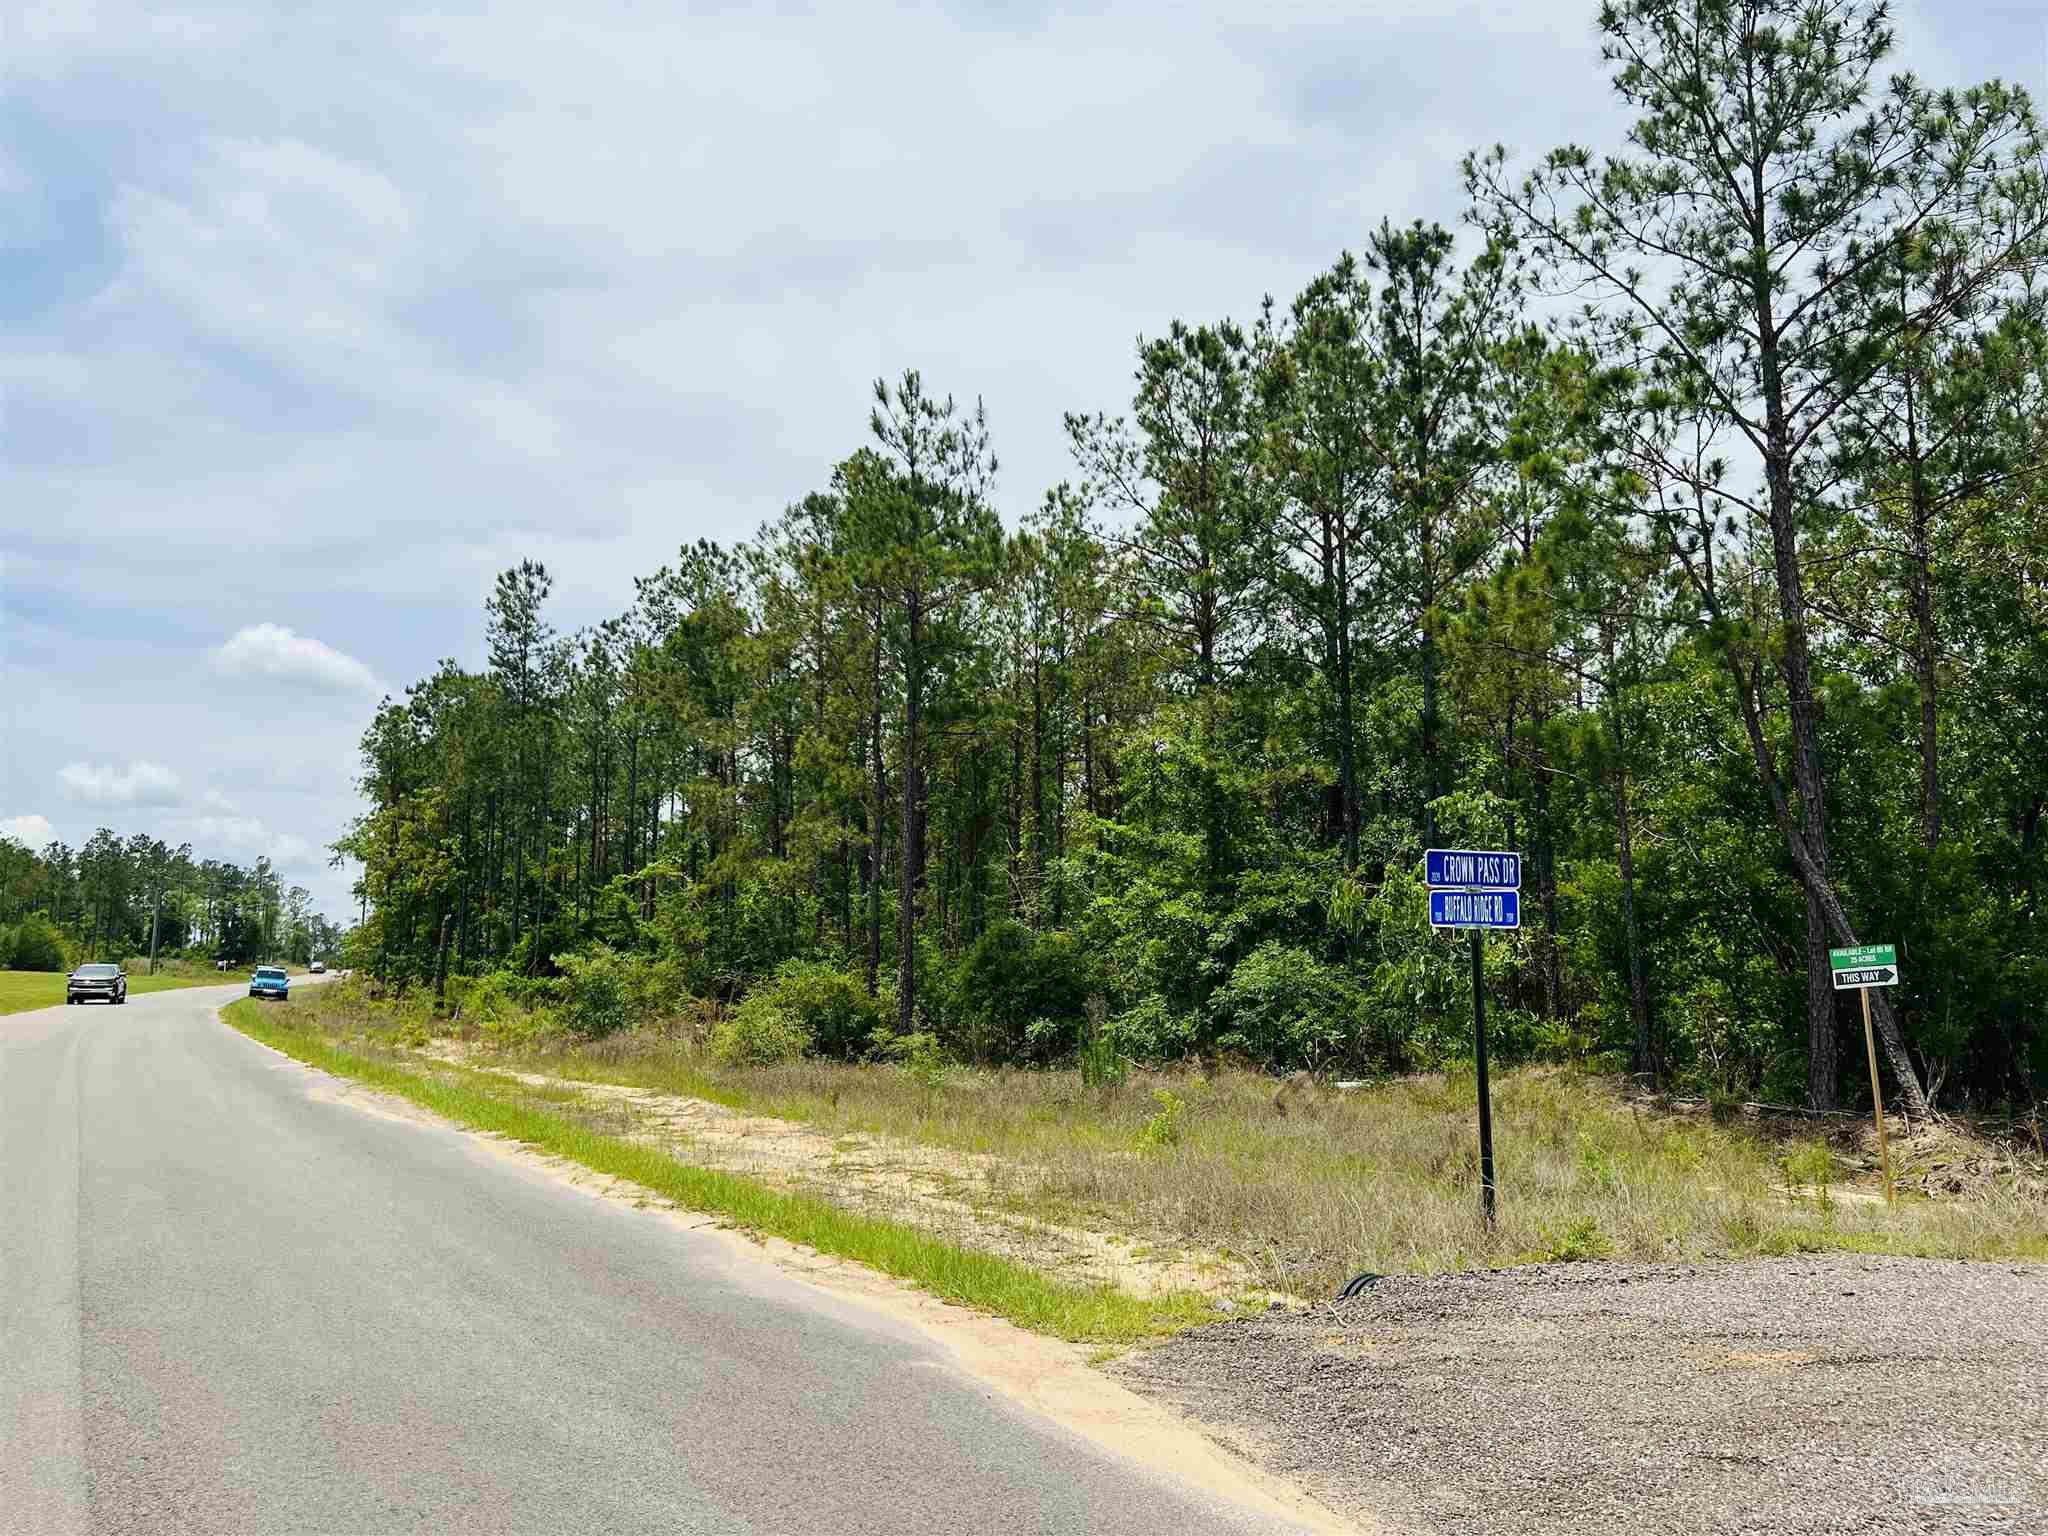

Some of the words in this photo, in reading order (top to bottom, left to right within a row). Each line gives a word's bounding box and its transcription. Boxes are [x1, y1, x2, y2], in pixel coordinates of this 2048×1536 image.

[1444, 855, 1474, 882] CROWN
[1478, 856, 1500, 884] PASS
[1503, 858, 1515, 884] DR
[1444, 895, 1472, 922] BUFFALO
[1474, 895, 1493, 922] RIDGE
[1494, 896, 1503, 922] RD
[1842, 973, 1860, 983] THIS
[1860, 971, 1879, 982] WAY
